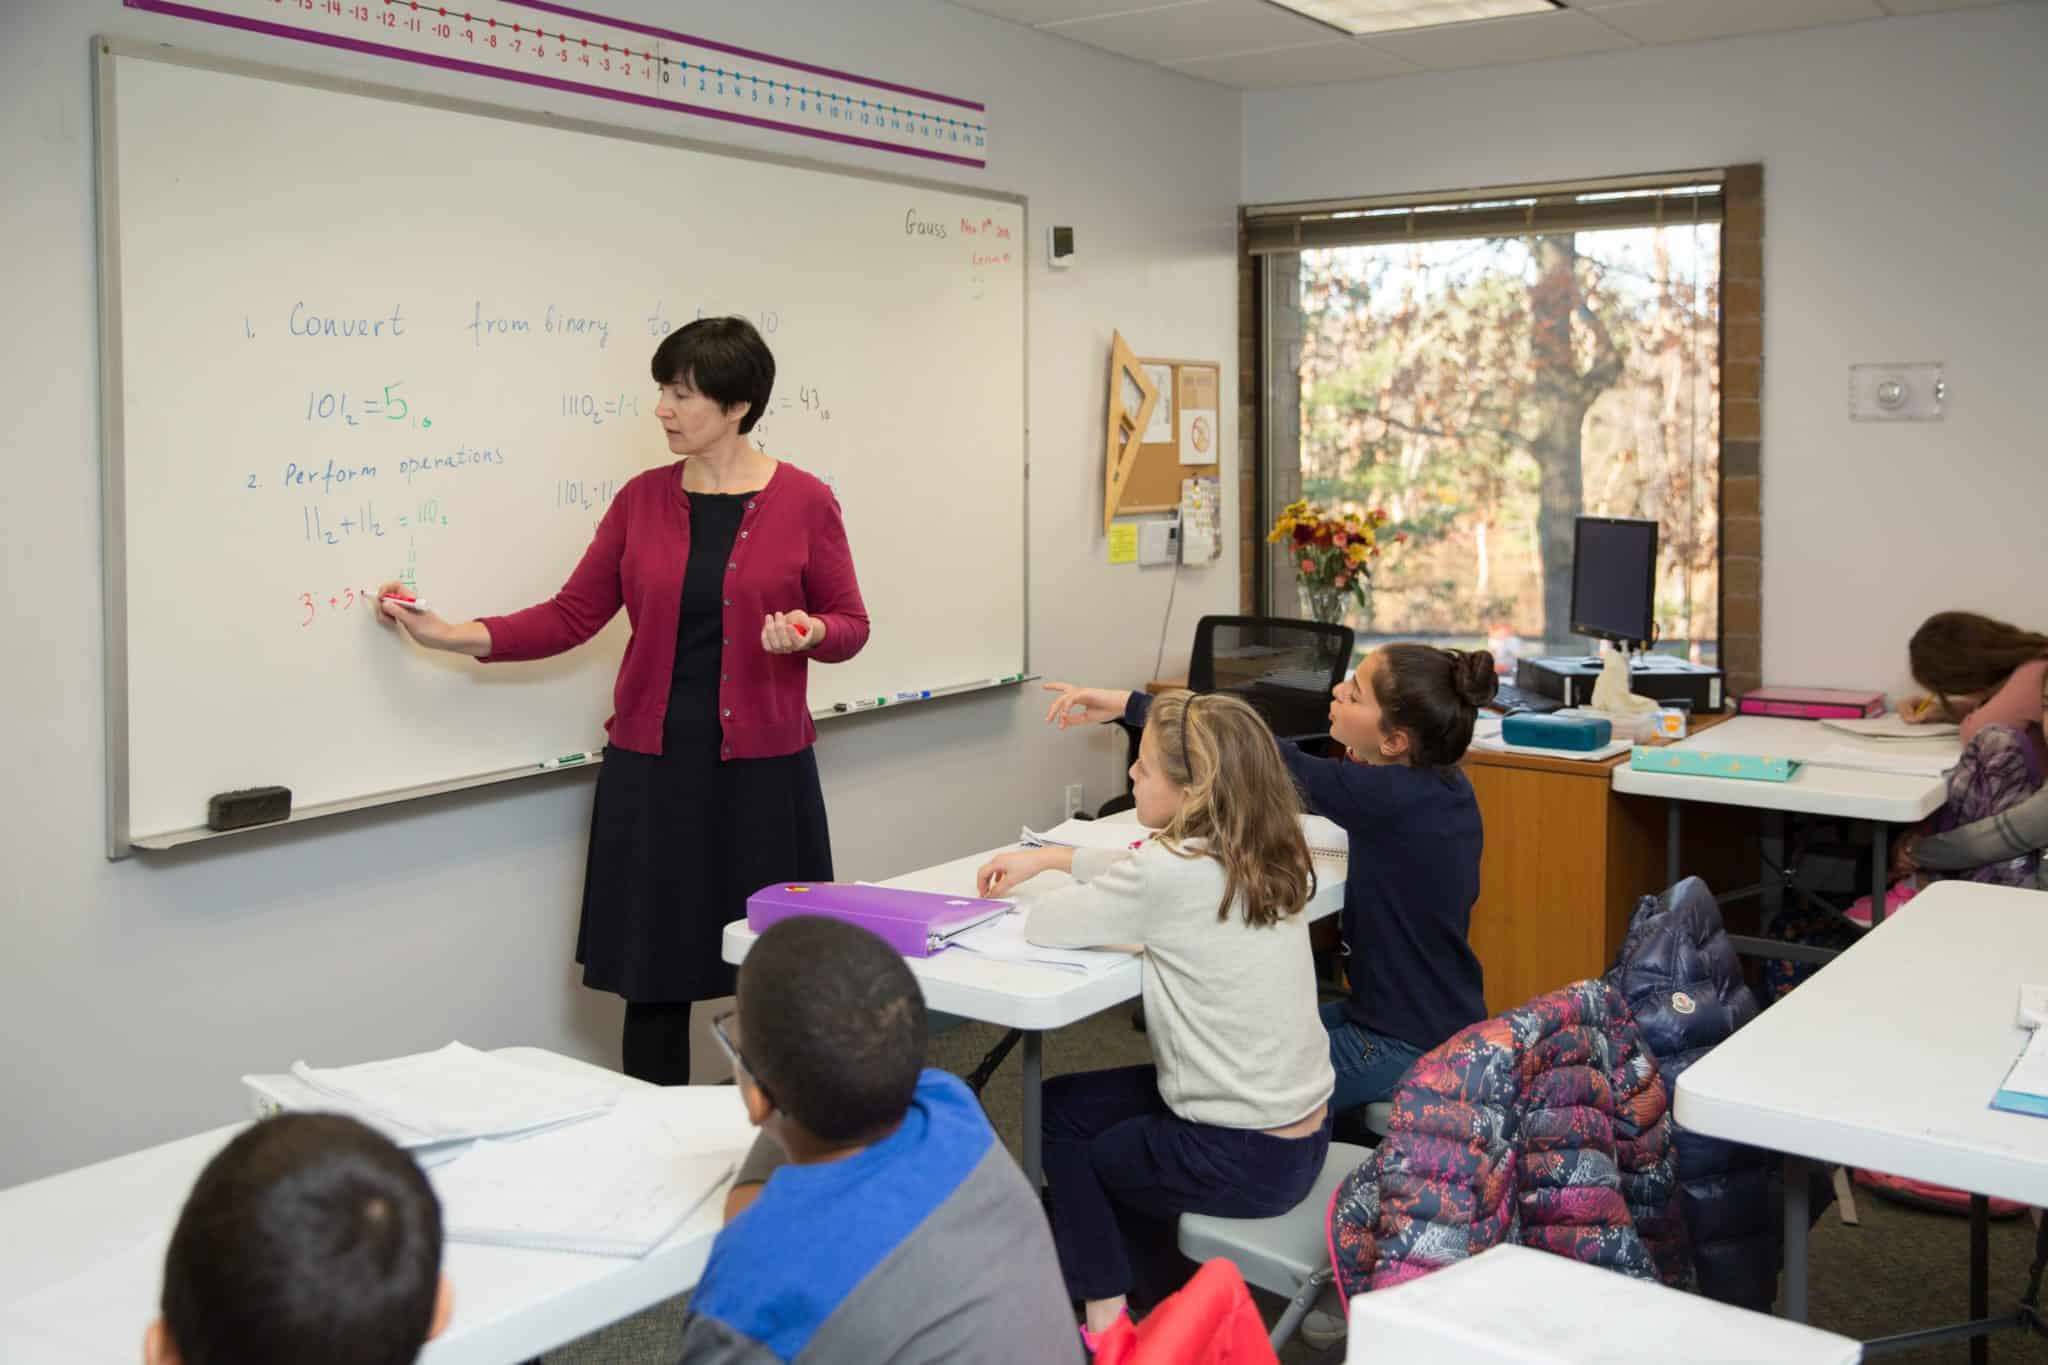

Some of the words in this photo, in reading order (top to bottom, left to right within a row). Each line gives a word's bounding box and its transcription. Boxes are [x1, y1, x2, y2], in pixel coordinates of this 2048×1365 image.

[349, 7, 369, 21] -13
[376, 12, 395, 28] -12
[404, 18, 420, 32] -11
[432, 23, 450, 38] -10
[460, 29, 473, 43] -9
[484, 34, 497, 48] -8
[509, 39, 522, 52] -7
[532, 44, 544, 58] -6
[556, 49, 567, 63] -5
[578, 54, 589, 67] -4
[600, 58, 610, 71] -3
[620, 63, 630, 76] -2
[642, 67, 650, 80] -1
[663, 71, 669, 83] 0
[905, 207, 947, 239] Gauss
[245, 315, 256, 338] 1.
[288, 301, 405, 337] Convert
[467, 300, 530, 347] from
[544, 304, 609, 348] binary
[647, 301, 671, 336] to
[284, 460, 377, 493] Perform
[399, 445, 504, 484] operations
